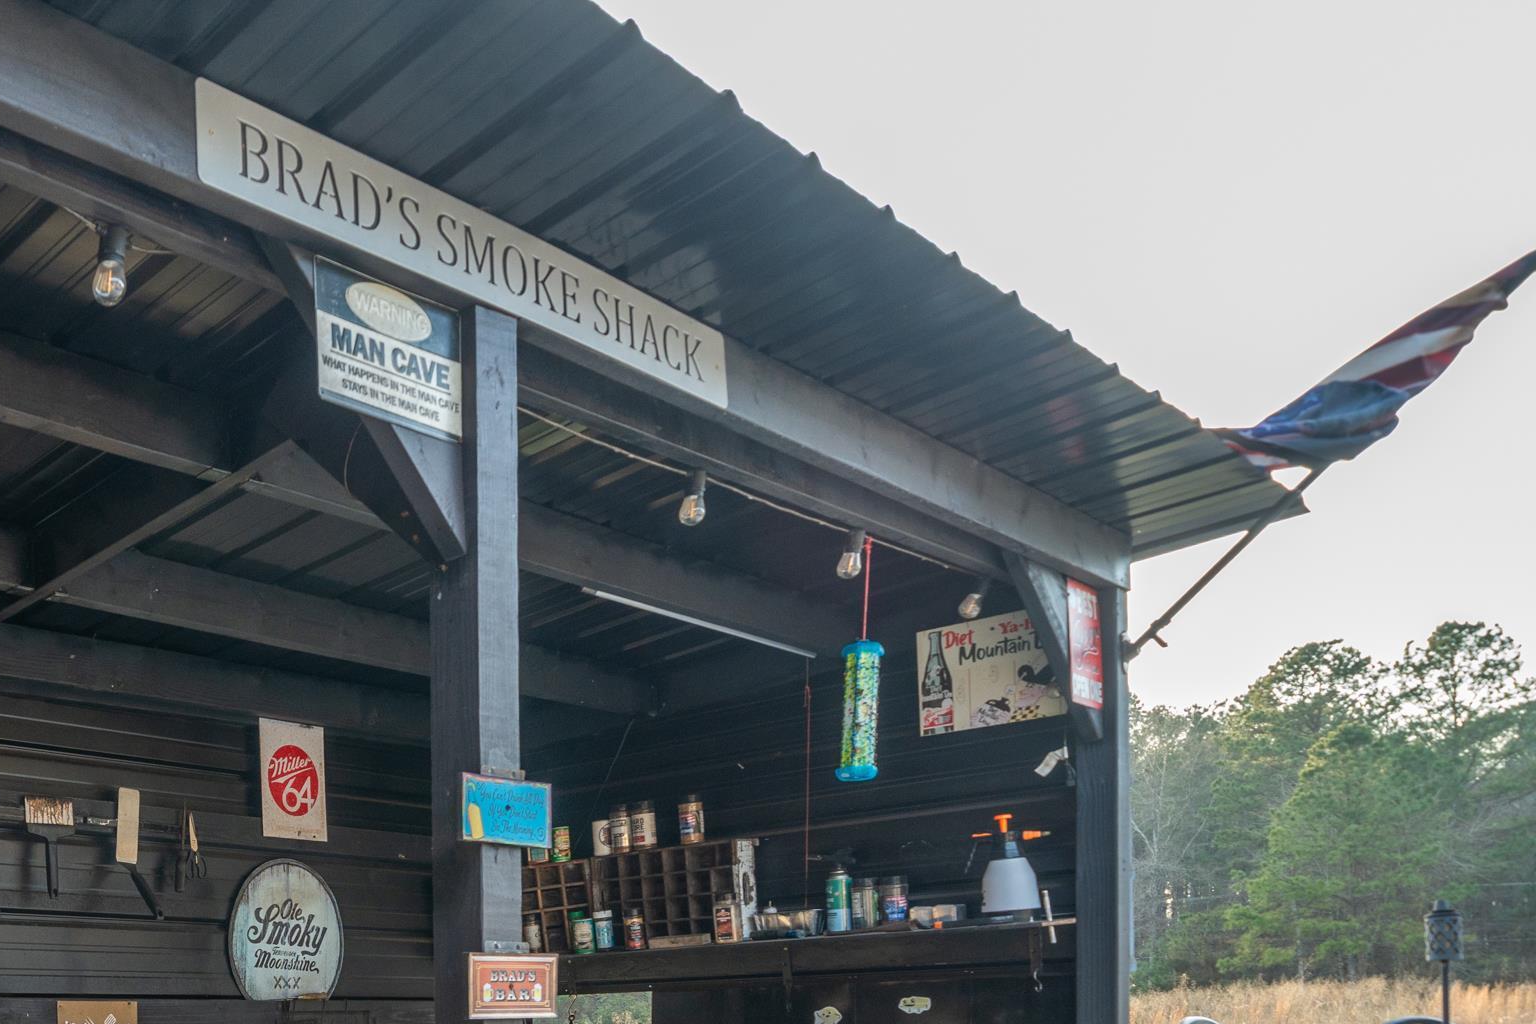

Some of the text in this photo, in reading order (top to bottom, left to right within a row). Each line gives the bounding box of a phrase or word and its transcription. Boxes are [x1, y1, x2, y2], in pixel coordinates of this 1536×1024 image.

[238, 119, 706, 383] BRAD'S SMOKE SHACK
[356, 289, 429, 332] WARNING
[331, 323, 450, 390] MAN CAVE
[322, 354, 460, 413] WHAT HAPPENS IN THE MAN CAVE
[342, 379, 440, 421] STAYS IN THE MAN CAVE
[943, 629, 975, 649] Diet
[959, 636, 1030, 665] Mountain
[269, 757, 311, 777] Miller
[282, 776, 314, 812] 64
[280, 898, 305, 922] Ole
[247, 903, 328, 955] Smoky
[254, 949, 319, 974] Moonshine
[490, 969, 536, 982] BRAD'S
[273, 976, 301, 989] XXX
[495, 988, 530, 1002] BAR
